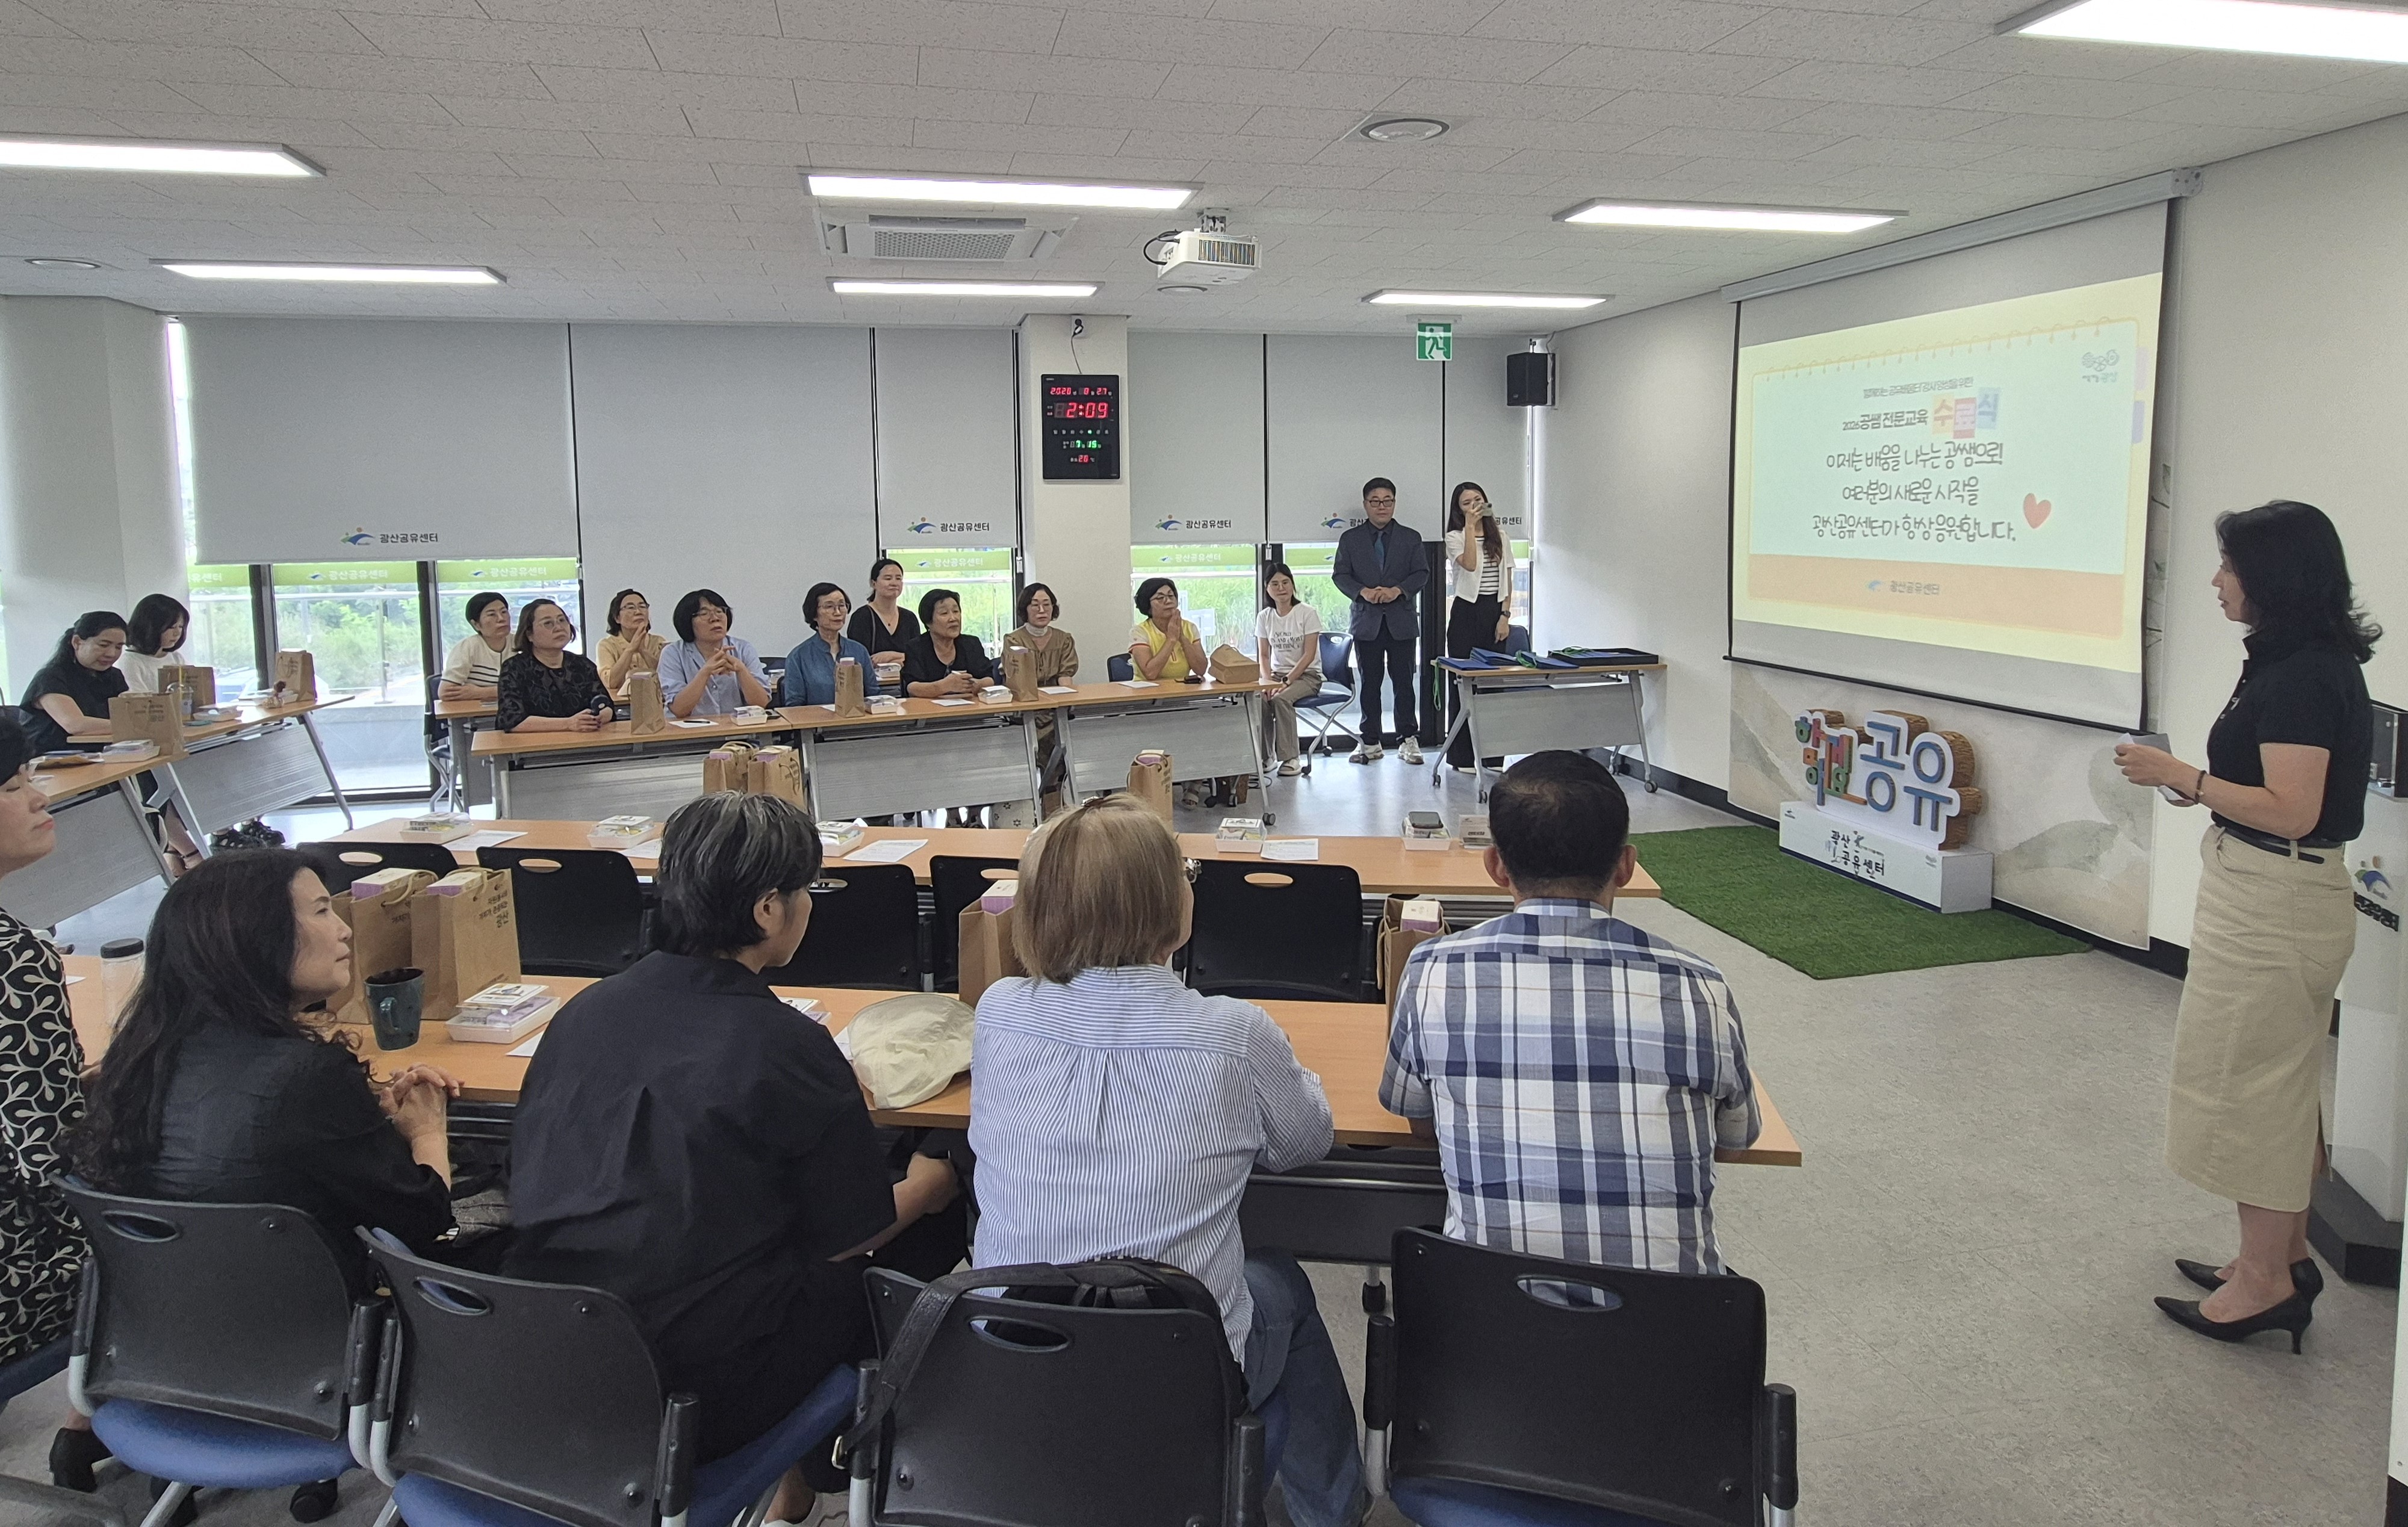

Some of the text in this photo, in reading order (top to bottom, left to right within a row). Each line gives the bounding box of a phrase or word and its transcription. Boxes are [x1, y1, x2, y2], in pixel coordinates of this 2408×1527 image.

[1066, 402, 1108, 418] 2:09
[1882, 409, 1928, 429] 전문교육
[1826, 447, 1863, 472] 이제는
[1866, 444, 1901, 472] 배움을
[1904, 442, 1941, 469] 나누는
[1842, 475, 1979, 506] 여러분의 새로운 시작을
[940, 522, 990, 532] 광산공유센터
[1185, 519, 1232, 529] 광산공유센터
[1812, 513, 2017, 542] 광산공유센터가 항상 응원합니다.
[379, 533, 439, 544] 광산공유센터
[934, 557, 984, 568] 광산공유센터
[1175, 554, 1221, 563] 광산공유센터
[328, 569, 388, 580] 광산공유센터
[490, 566, 547, 578] 광산공유센터
[1860, 720, 1953, 832] 공유
[1831, 829, 1851, 849] 광산
[1841, 850, 1885, 879] 공유센터
